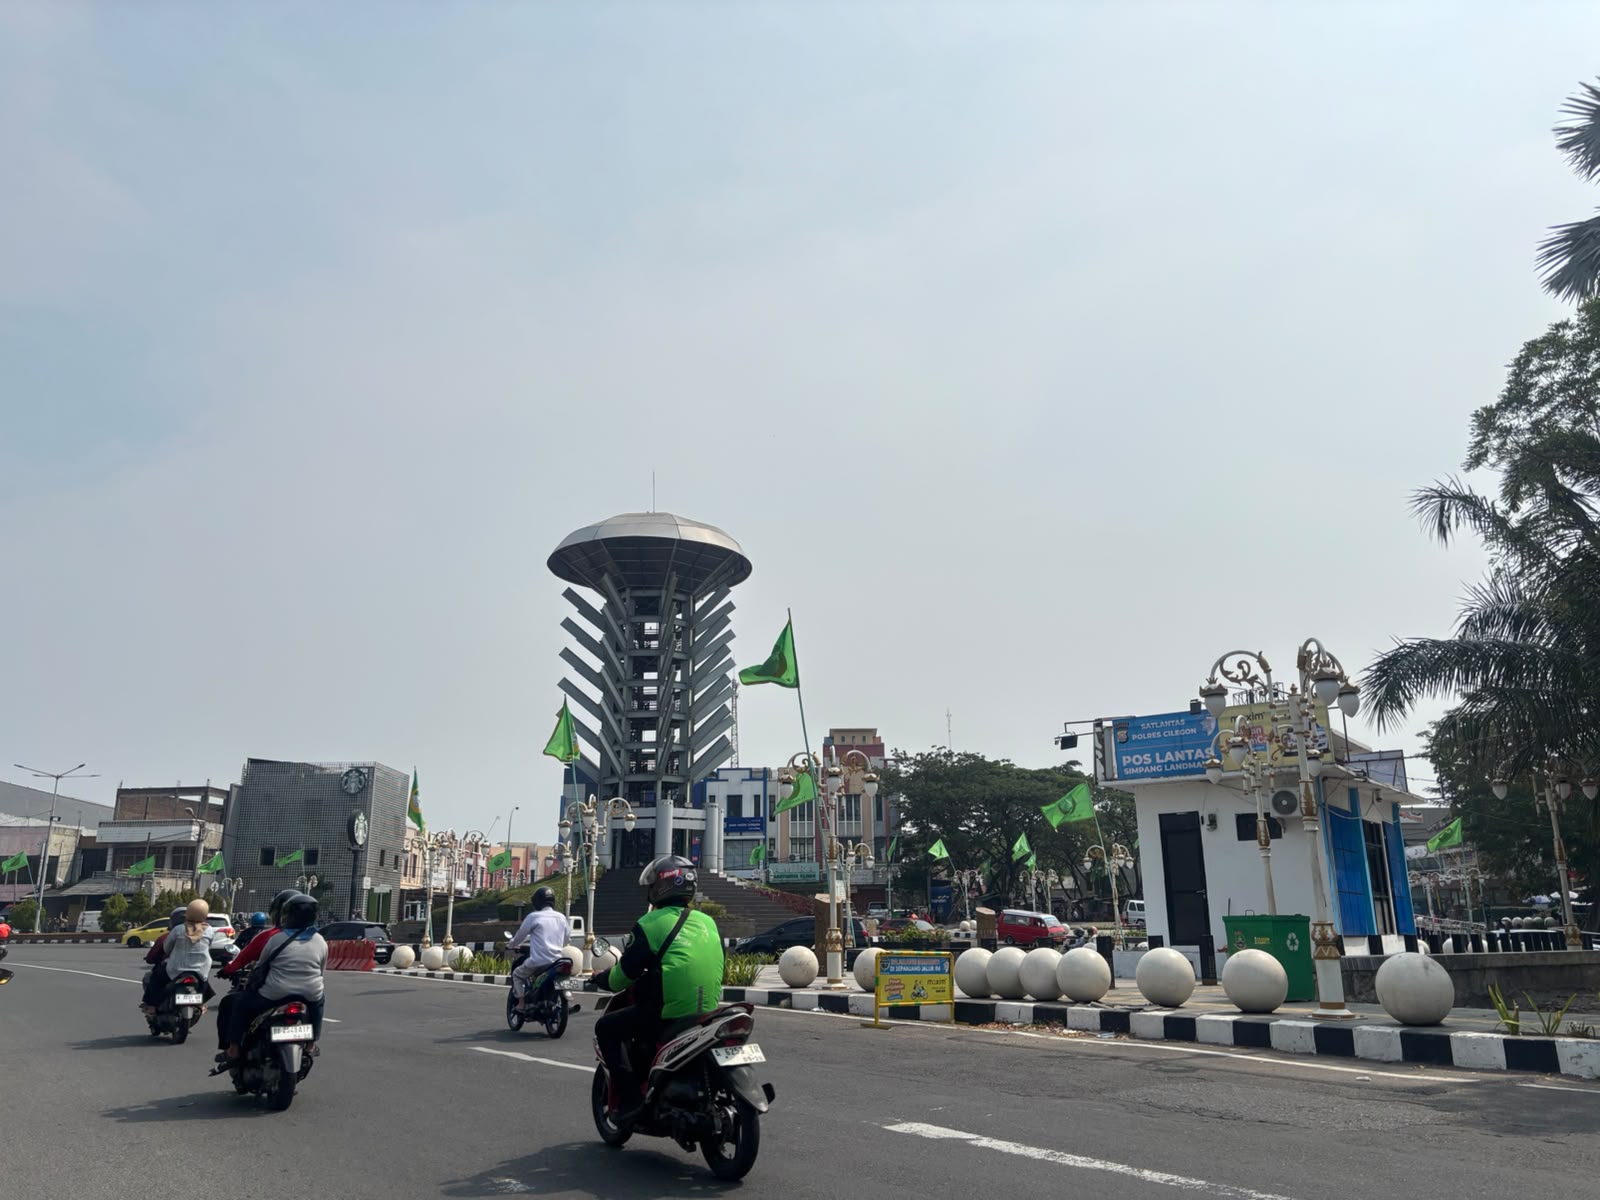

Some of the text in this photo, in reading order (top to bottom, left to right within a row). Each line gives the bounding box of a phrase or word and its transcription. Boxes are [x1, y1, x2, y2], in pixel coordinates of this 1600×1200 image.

[1140, 719, 1185, 730] SATLANTAS
[1132, 728, 1197, 740] POLRES CILEGON
[1122, 748, 1213, 766] POS LANTAS
[1123, 765, 1163, 775] SIMPANG
